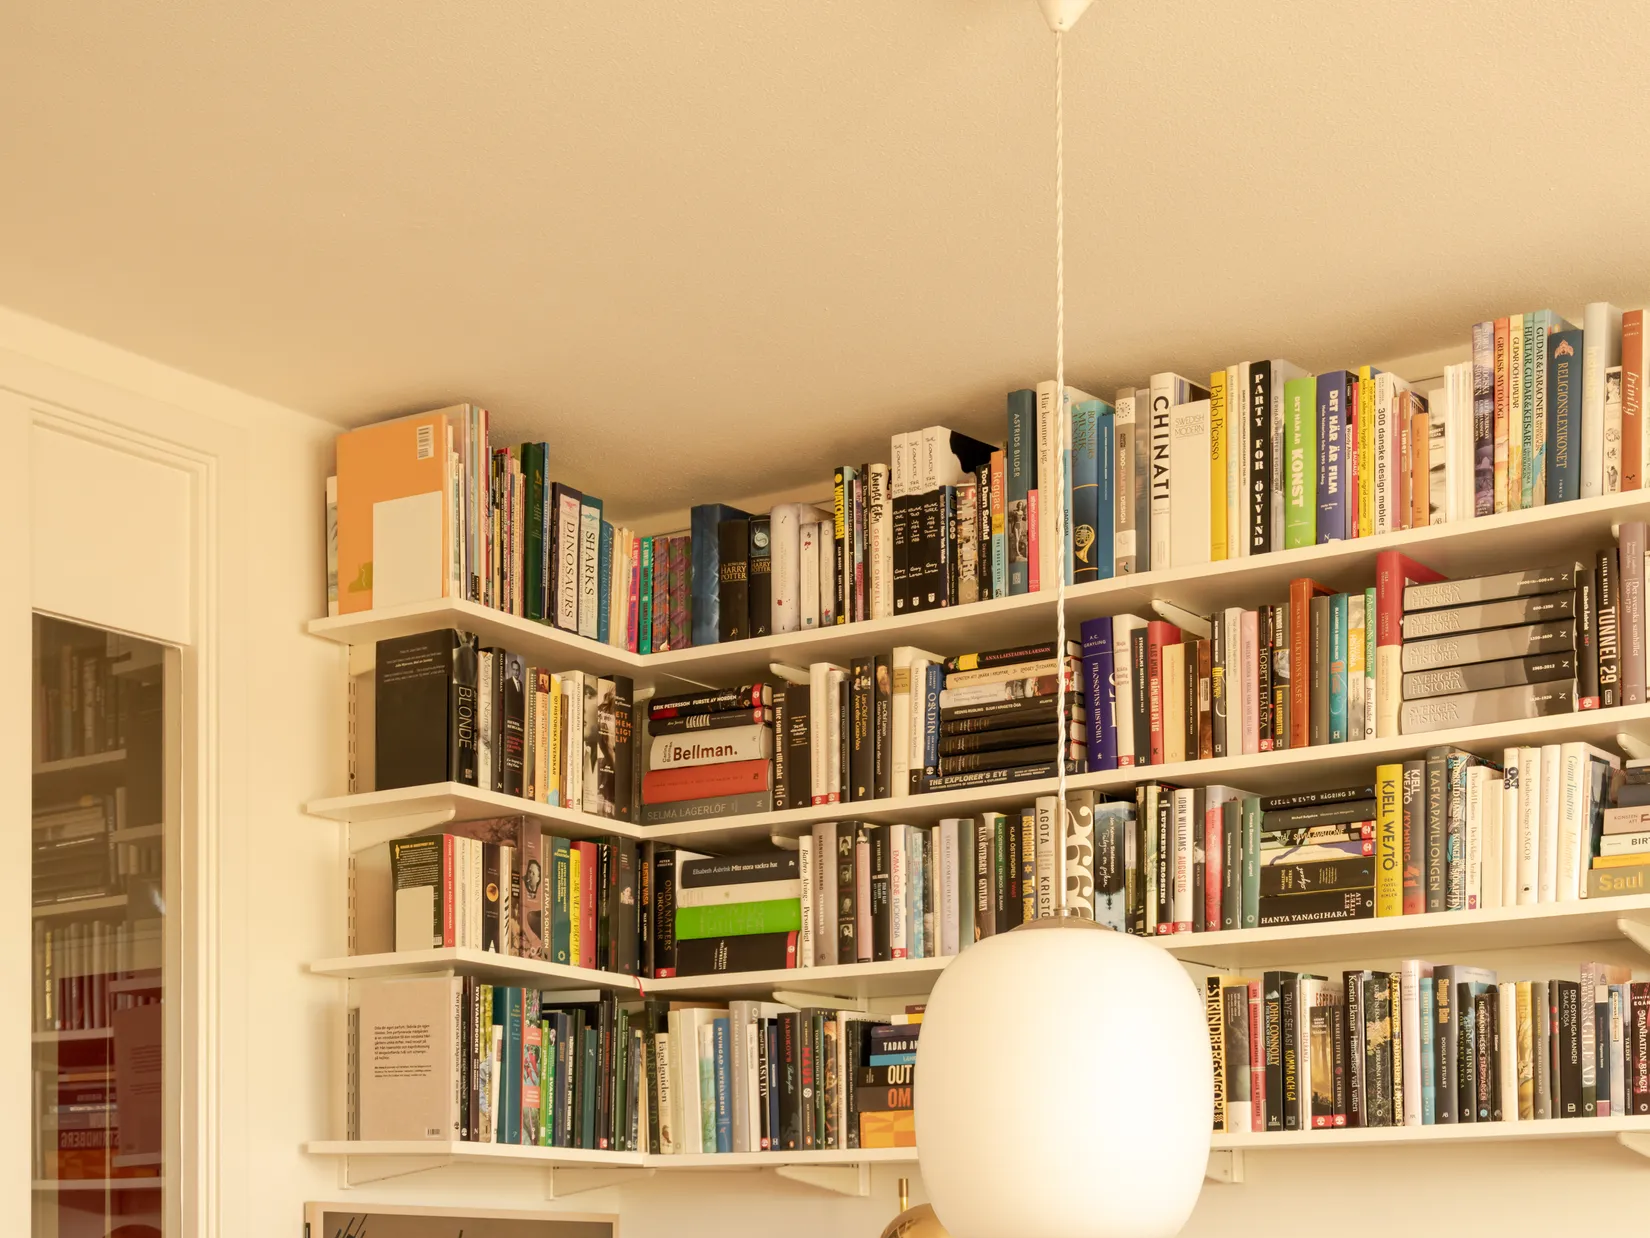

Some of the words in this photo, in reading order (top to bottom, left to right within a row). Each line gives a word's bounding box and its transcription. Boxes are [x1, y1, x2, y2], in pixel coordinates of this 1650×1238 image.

[1211, 385, 1223, 417] Pablo
[1254, 374, 1264, 427] PARTY
[1329, 390, 1339, 412] DET
[1622, 371, 1639, 416] trinity
[1174, 413, 1205, 427] SWEDISH
[1329, 415, 1340, 442] HÄR
[1378, 408, 1386, 426] 300
[1556, 362, 1568, 469] RELIGIONSLEXIKONET
[1013, 413, 1021, 448] ASTRIDS
[1078, 412, 1086, 450] MUSIK
[1174, 424, 1205, 437] MODERN
[1211, 419, 1223, 461] Picasso
[1153, 396, 1169, 501] CHINATI
[1255, 439, 1264, 471] FOR
[1329, 445, 1340, 463] ÄR
[1378, 428, 1386, 461] danske
[871, 472, 882, 503] ANIMAL
[991, 472, 1002, 509] Reggae
[1328, 465, 1338, 495] FILM
[1377, 463, 1386, 494] design
[835, 485, 844, 539] WATCHMEN
[871, 504, 882, 524] FARM
[1254, 480, 1264, 547] ÖYVIND
[1377, 496, 1386, 526] møbler
[565, 522, 575, 618] DINOSAURS
[585, 531, 595, 596] SHARKS
[721, 566, 747, 574] HARRY
[721, 573, 747, 581] POTTER
[1411, 584, 1460, 598] SVERIGES
[1412, 591, 1462, 608] HISTORIA
[1632, 581, 1640, 594] Det
[1411, 611, 1459, 627] SVERIGES
[1411, 619, 1460, 636] HISTORIA
[1083, 639, 1107, 648] GRAYLING
[1599, 606, 1615, 664] TUNNEL
[1632, 624, 1640, 656] samhället
[1411, 669, 1460, 686] SVERIGES
[1412, 679, 1462, 694] HISTORIA
[1600, 666, 1617, 684] 29
[615, 711, 629, 719] ETT
[653, 703, 666, 711] ERIK
[667, 700, 691, 709] PETERSSON
[692, 698, 708, 706] FURSTE
[717, 694, 737, 704] NORDEN
[927, 692, 936, 734] ORDEN
[458, 686, 472, 749] BLONDE
[615, 720, 633, 728] HEM-
[673, 744, 738, 761] Bellman.
[929, 777, 943, 787] THE
[944, 771, 990, 785] EXPLORER'S
[991, 770, 1008, 779] EYE
[1177, 797, 1187, 814] JOHN
[1382, 780, 1395, 817] KJELL
[647, 808, 678, 822] SELMA
[679, 803, 727, 819] LAGERLÖF
[1523, 808, 1531, 830] Singer
[978, 827, 987, 841] KLAS
[1177, 815, 1187, 852] WILLIAMS
[1430, 770, 1440, 891] KAFKAPAVILJONGEN
[978, 842, 988, 875] ÖSTERGREN
[1383, 821, 1398, 871] WESTÖ
[1177, 855, 1187, 893] AUGUSTUS
[1599, 871, 1643, 891] Saul
[664, 880, 673, 907] ONDA
[801, 878, 809, 902] Alving:
[979, 878, 988, 911] GENTLEMEN
[656, 892, 666, 940] DRÖMMAR
[893, 898, 901, 939] FLICKORNA
[1261, 915, 1290, 924] HANYA
[1291, 911, 1348, 922] YANAGIHARA
[664, 910, 673, 951] NÄTTERS
[1348, 975, 1357, 1003] Kerstin
[1437, 979, 1450, 1006] Shuggie
[1269, 1002, 1279, 1025] JOHN
[1284, 992, 1293, 1016] TAIYE
[1349, 1004, 1358, 1031] Ekman
[1439, 1008, 1450, 1024] Bain
[1285, 1018, 1293, 1046] SELASI
[1637, 1010, 1649, 1062] MANHATTAN
[883, 1042, 907, 1051] TADAO
[1269, 1027, 1280, 1066] CONNOLLY
[1350, 1035, 1359, 1074] Händelser
[1582, 1022, 1595, 1086] GILEAD
[658, 1041, 668, 1102] Fågelguiden
[802, 1047, 813, 1085] MAUS
[887, 1065, 912, 1085] OUT
[1286, 1050, 1296, 1075] KOMMA
[1286, 1076, 1295, 1090] OCH
[1351, 1075, 1359, 1088] vid
[1638, 1063, 1649, 1092] BEACH
[888, 1088, 911, 1108] OM
[1286, 1091, 1296, 1101] GÅ
[1351, 1089, 1359, 1112] vatten
